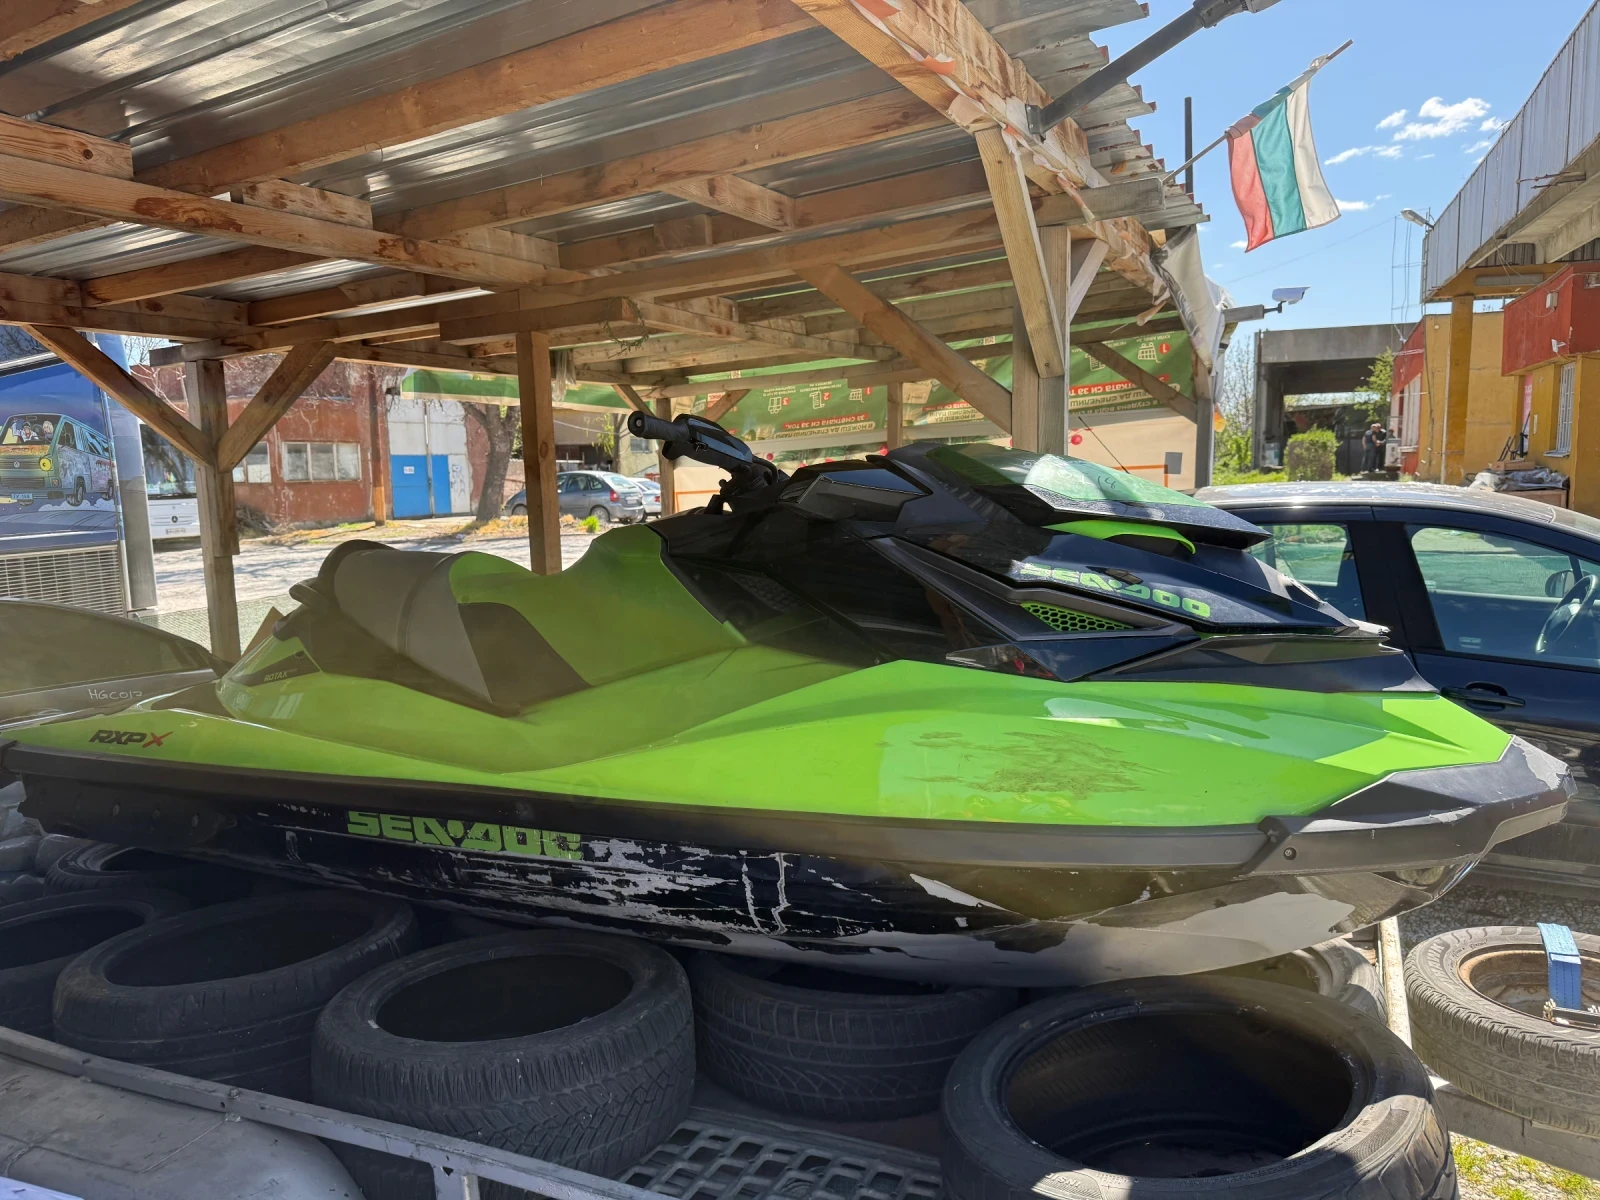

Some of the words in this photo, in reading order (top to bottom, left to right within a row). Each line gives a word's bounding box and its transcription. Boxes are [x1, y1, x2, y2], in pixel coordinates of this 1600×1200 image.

[1106, 383, 1137, 392] тката
[823, 392, 830, 400] 2
[1070, 396, 1117, 407] СПЕЧЕЛИШ
[795, 429, 829, 437] СПЕЧЕЛИШ
[264, 670, 288, 682] ROTAX
